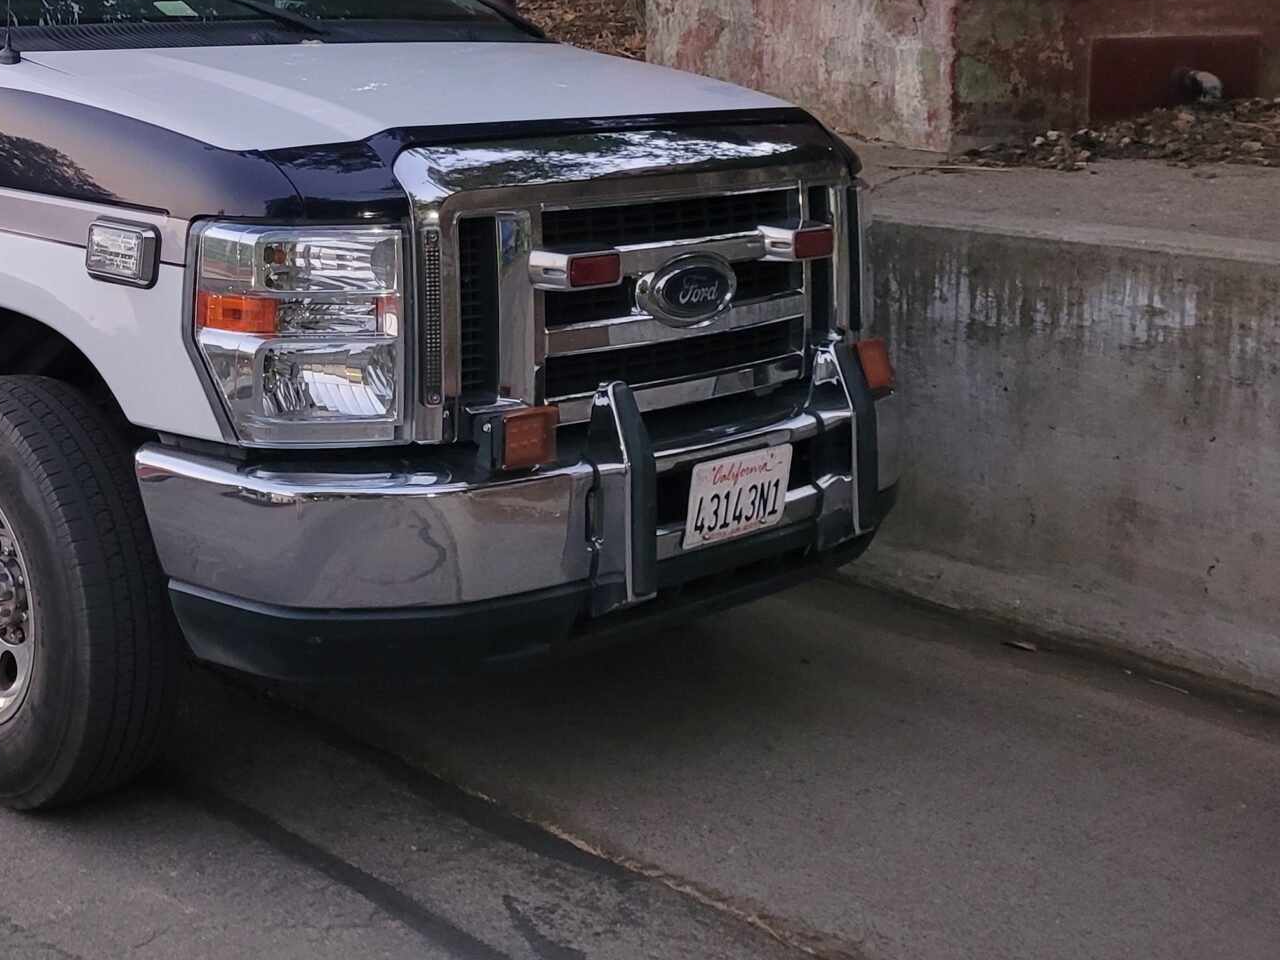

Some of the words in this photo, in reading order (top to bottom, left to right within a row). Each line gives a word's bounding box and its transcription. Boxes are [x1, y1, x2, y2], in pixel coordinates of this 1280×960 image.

[679, 274, 719, 305] Ford
[712, 461, 773, 486] California
[694, 478, 780, 535] 43143N1
